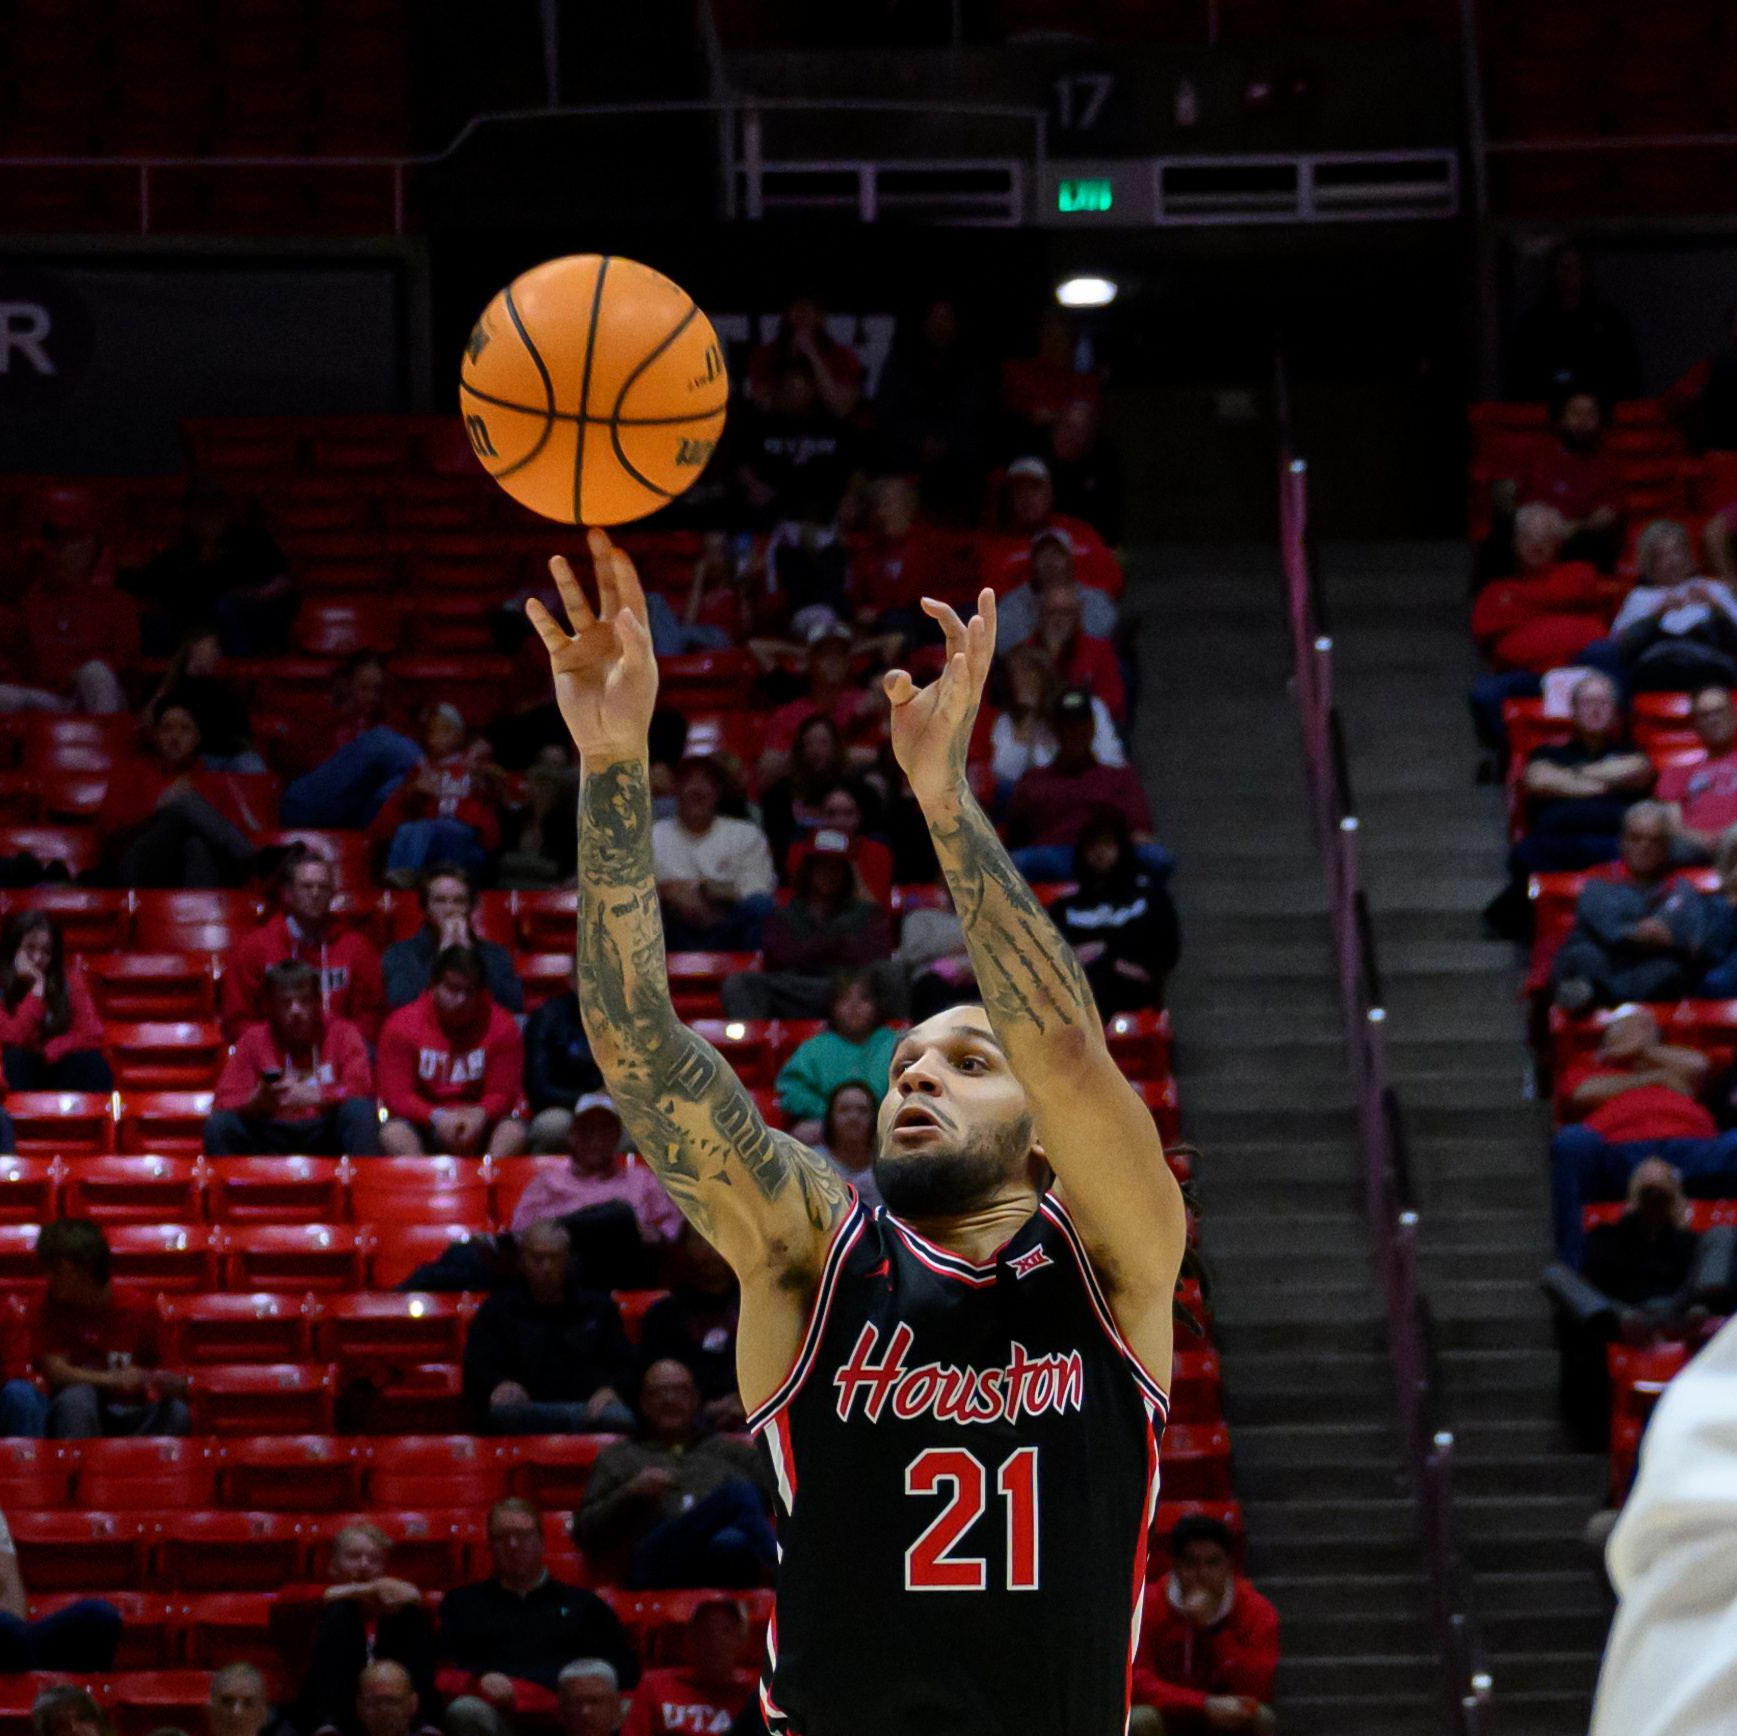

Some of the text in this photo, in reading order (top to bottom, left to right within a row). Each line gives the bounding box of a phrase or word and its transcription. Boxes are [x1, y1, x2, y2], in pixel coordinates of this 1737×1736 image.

[1054, 73, 1114, 130] 17
[417, 1046, 487, 1084] UTAH
[833, 1321, 1084, 1427] Houston
[905, 1447, 1040, 1591] 21
[661, 1702, 732, 1734] UTA
